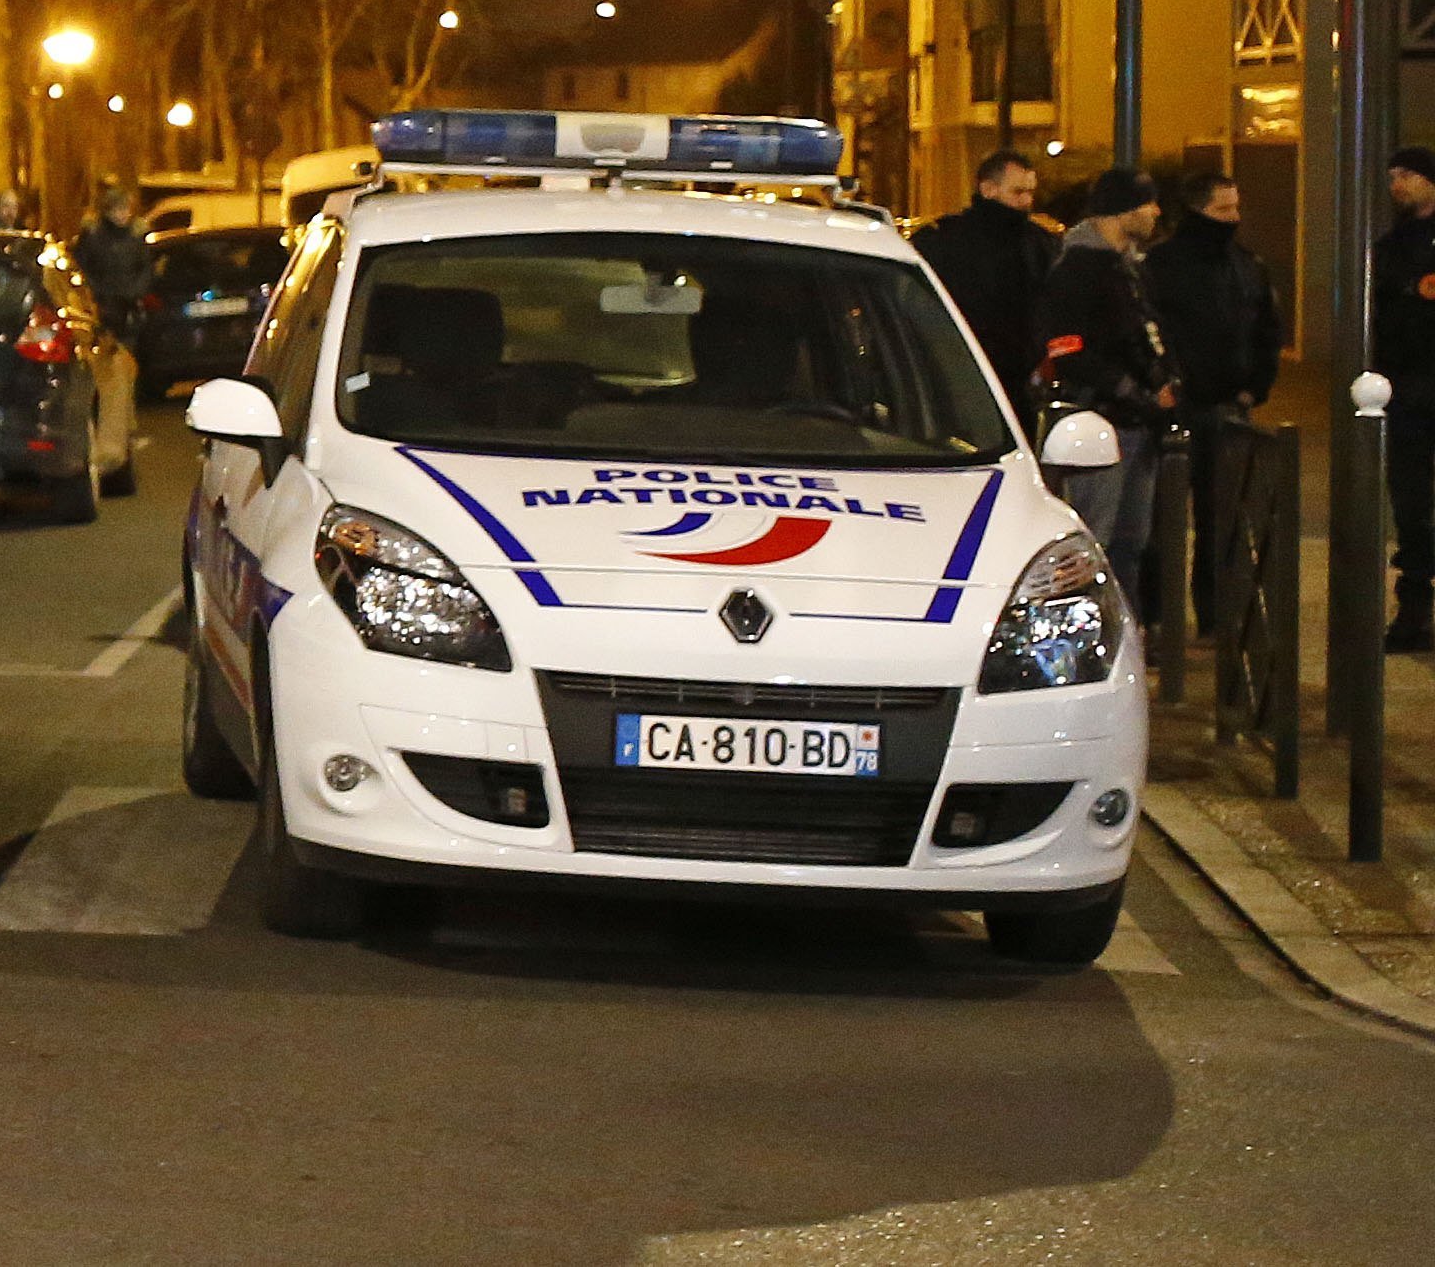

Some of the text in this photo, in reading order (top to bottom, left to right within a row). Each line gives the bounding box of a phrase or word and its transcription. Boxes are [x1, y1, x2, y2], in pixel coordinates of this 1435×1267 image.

[592, 468, 839, 492] POLICE
[521, 488, 928, 522] NATIONALE
[647, 722, 852, 768] CA-810-BD
[855, 750, 878, 771] 78
